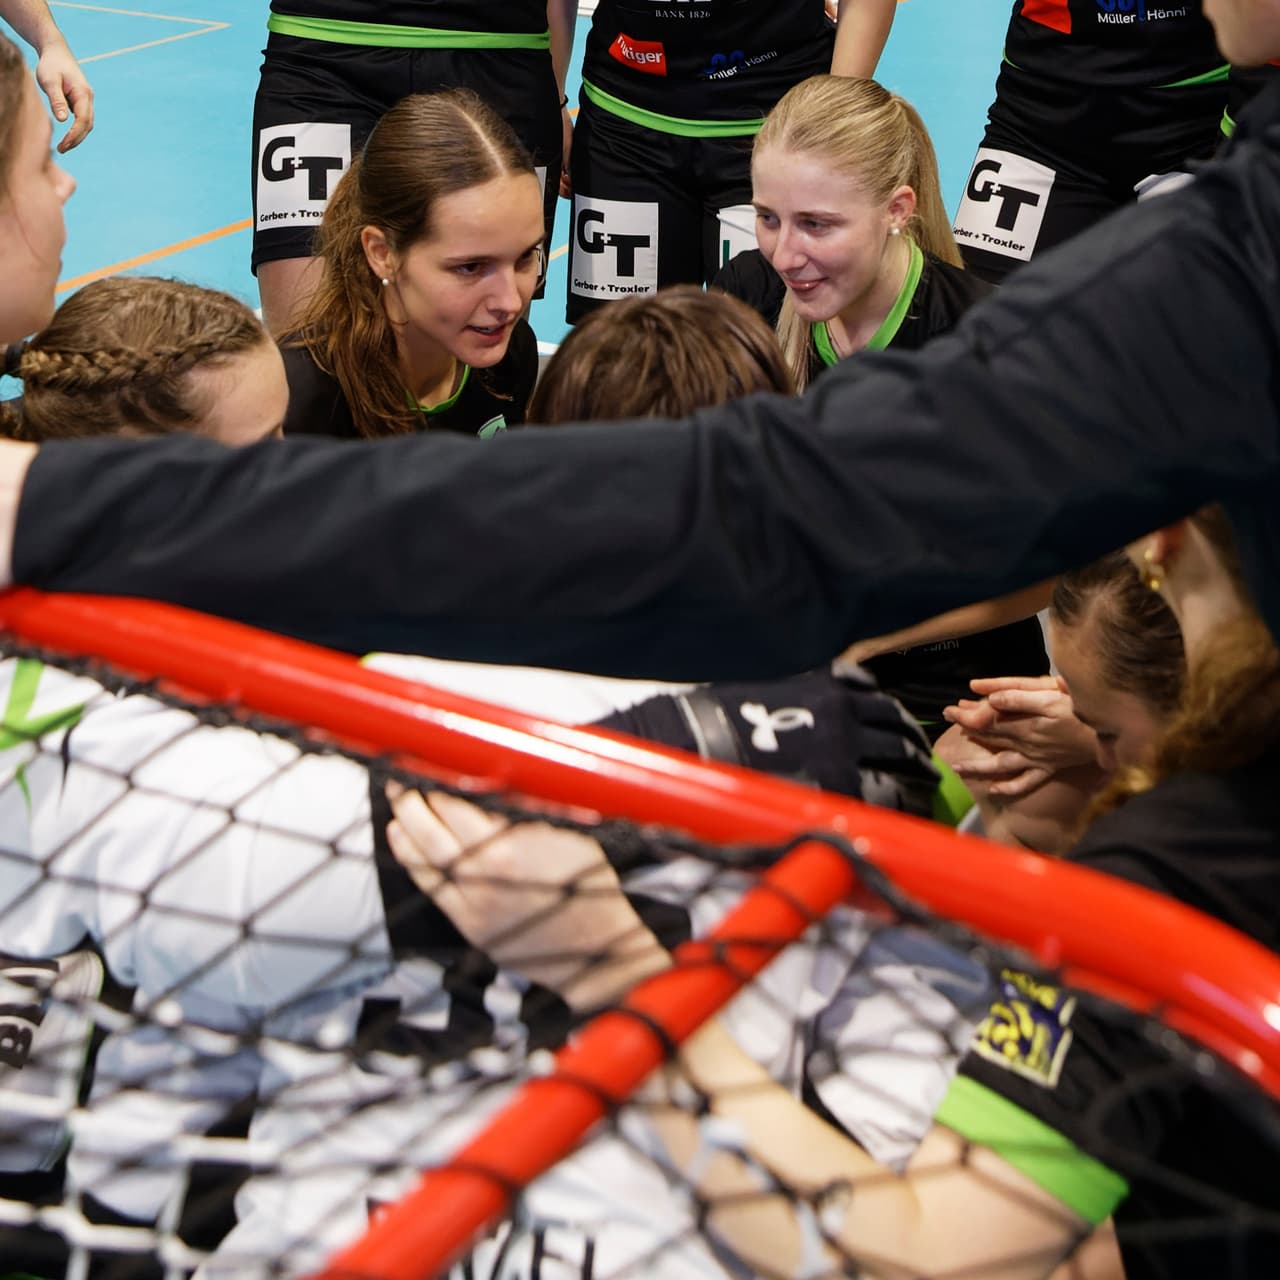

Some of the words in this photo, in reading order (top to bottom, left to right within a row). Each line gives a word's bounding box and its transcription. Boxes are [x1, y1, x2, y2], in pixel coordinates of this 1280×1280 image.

[655, 8, 685, 19] BANK
[689, 9, 711, 19] 1826
[1097, 12, 1136, 24] Müller
[260, 211, 287, 222] Gerber
[982, 233, 1025, 252] Troxler
[574, 279, 597, 291] Gerber
[608, 284, 650, 293] Troxler
